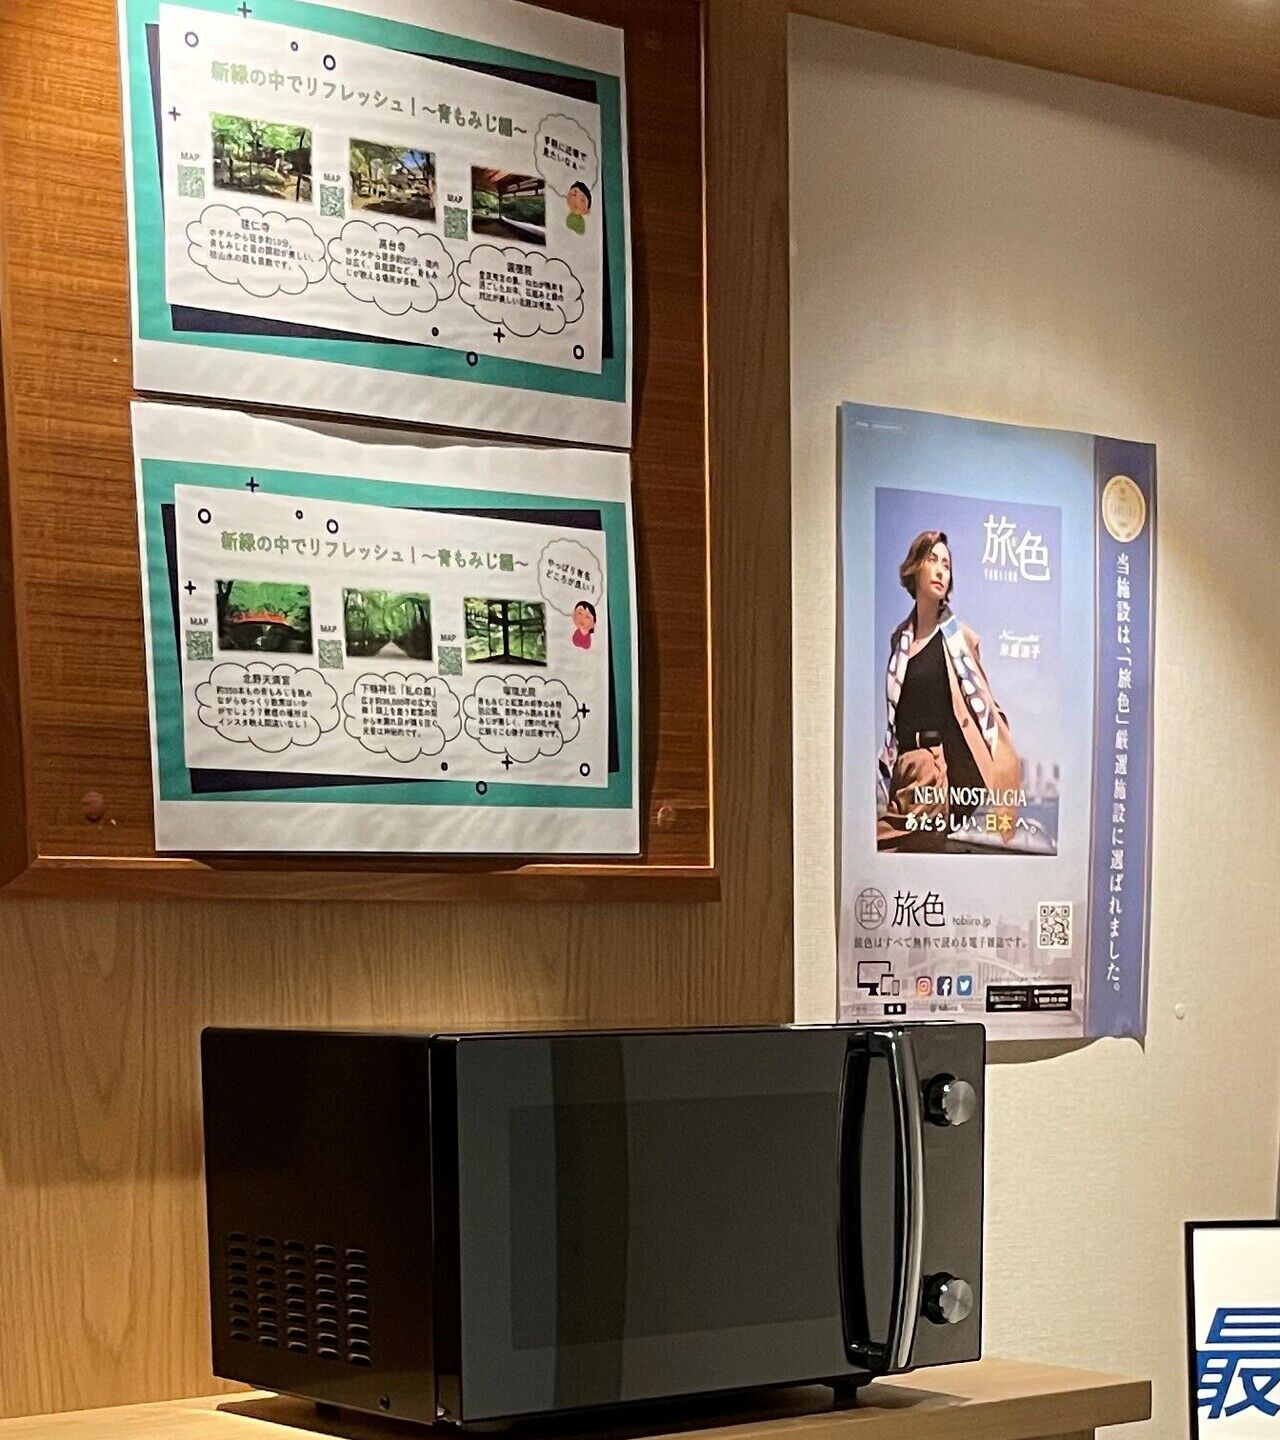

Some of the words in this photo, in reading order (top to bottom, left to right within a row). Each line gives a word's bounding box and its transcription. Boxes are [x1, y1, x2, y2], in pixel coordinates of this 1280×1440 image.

[180, 151, 200, 161] MAP
[981, 514, 1051, 582] 旅色
[189, 617, 209, 627] MAP
[914, 785, 948, 806] NEW
[949, 785, 1028, 807] NOSTALGIA
[905, 811, 1037, 835] あたらしい、日本へ。
[891, 890, 946, 928] 旅色
